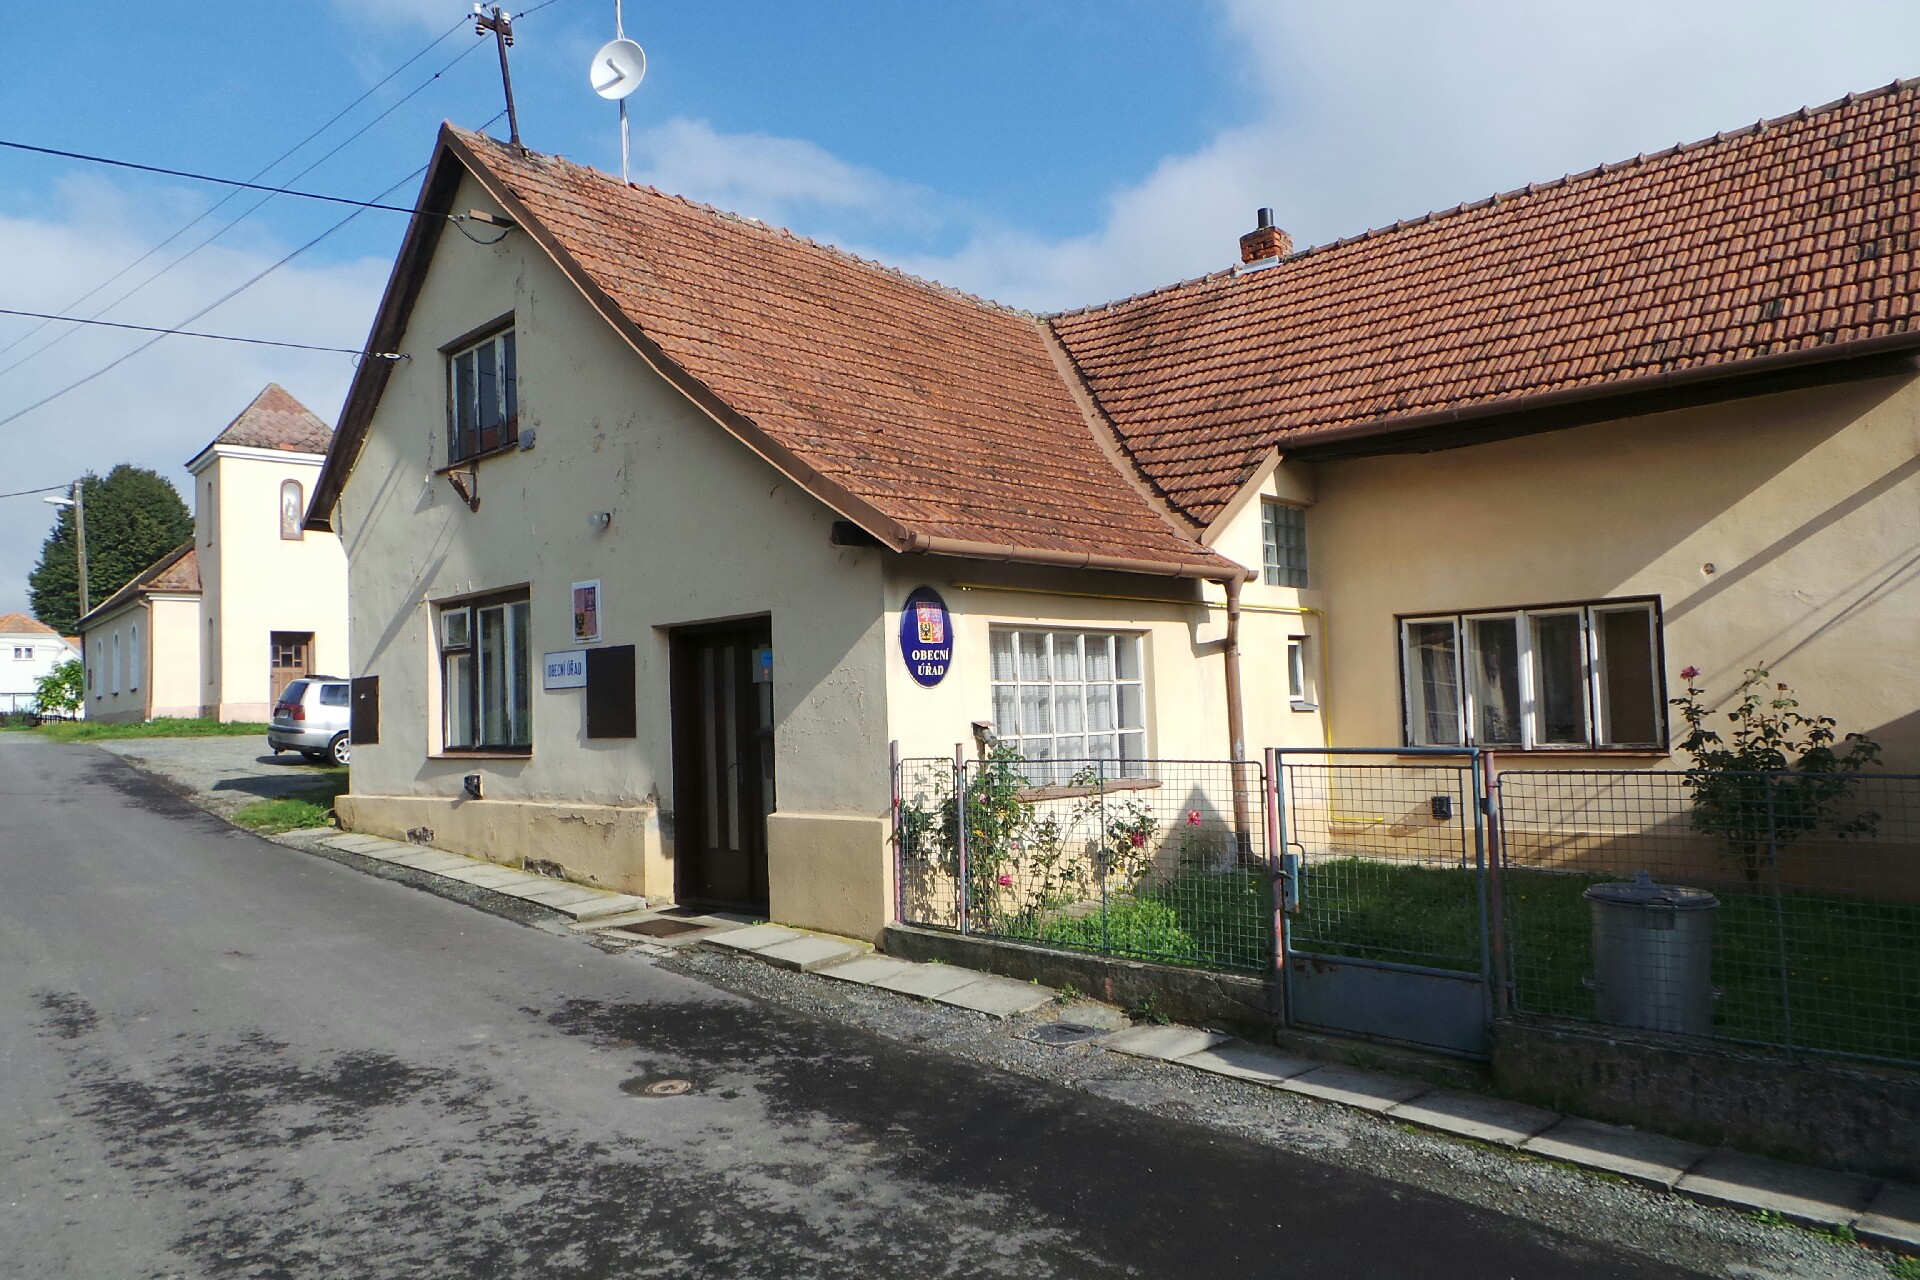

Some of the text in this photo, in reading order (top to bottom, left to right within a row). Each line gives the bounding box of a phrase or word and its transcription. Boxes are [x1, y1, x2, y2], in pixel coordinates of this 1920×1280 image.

[911, 647, 949, 661] OBECNÍ
[548, 659, 581, 677] OBECNÍ ÚŘAD
[917, 662, 944, 676] ÚŘAD
